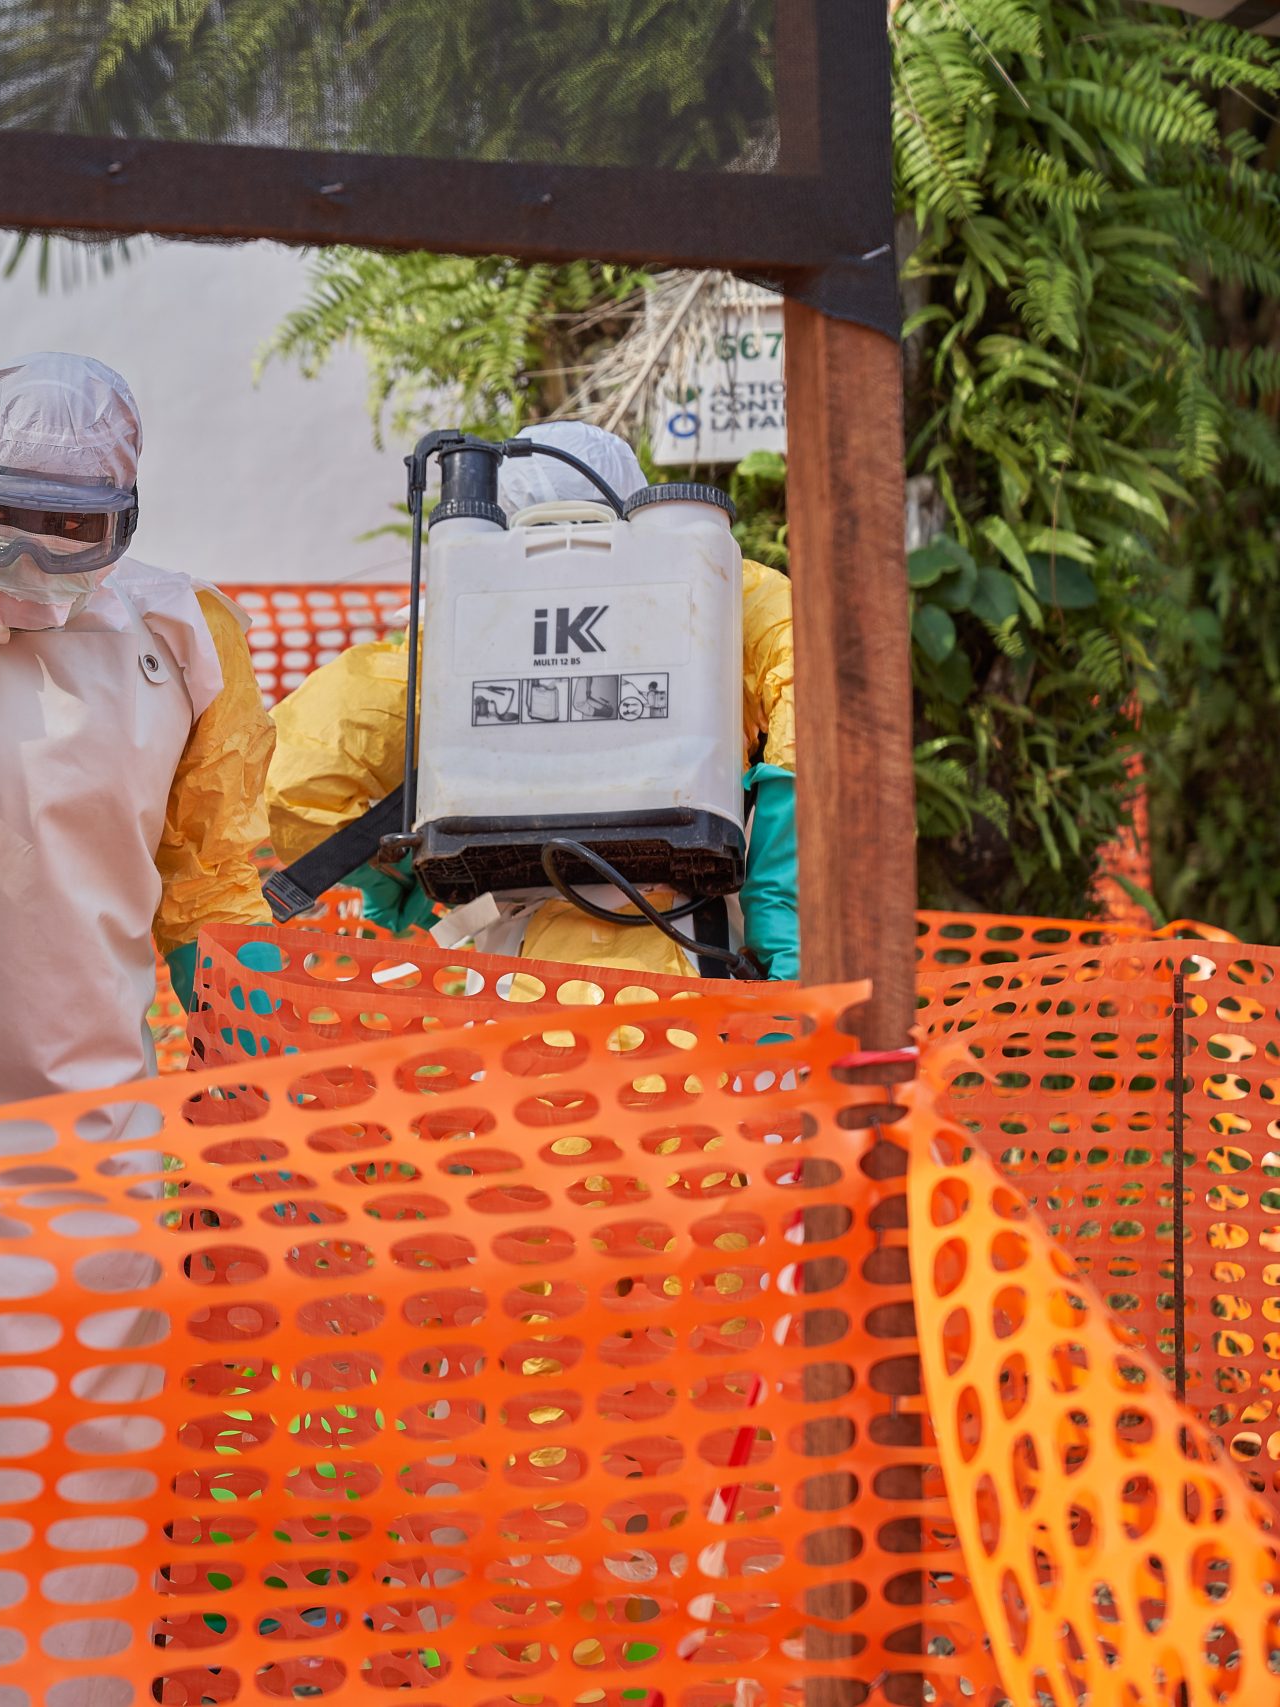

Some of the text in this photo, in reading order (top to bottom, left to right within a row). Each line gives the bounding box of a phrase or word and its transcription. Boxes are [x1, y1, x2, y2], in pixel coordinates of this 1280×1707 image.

[710, 398, 786, 415] CONT
[711, 416, 741, 432] LA
[533, 657, 581, 667] MULTI 12 BS
